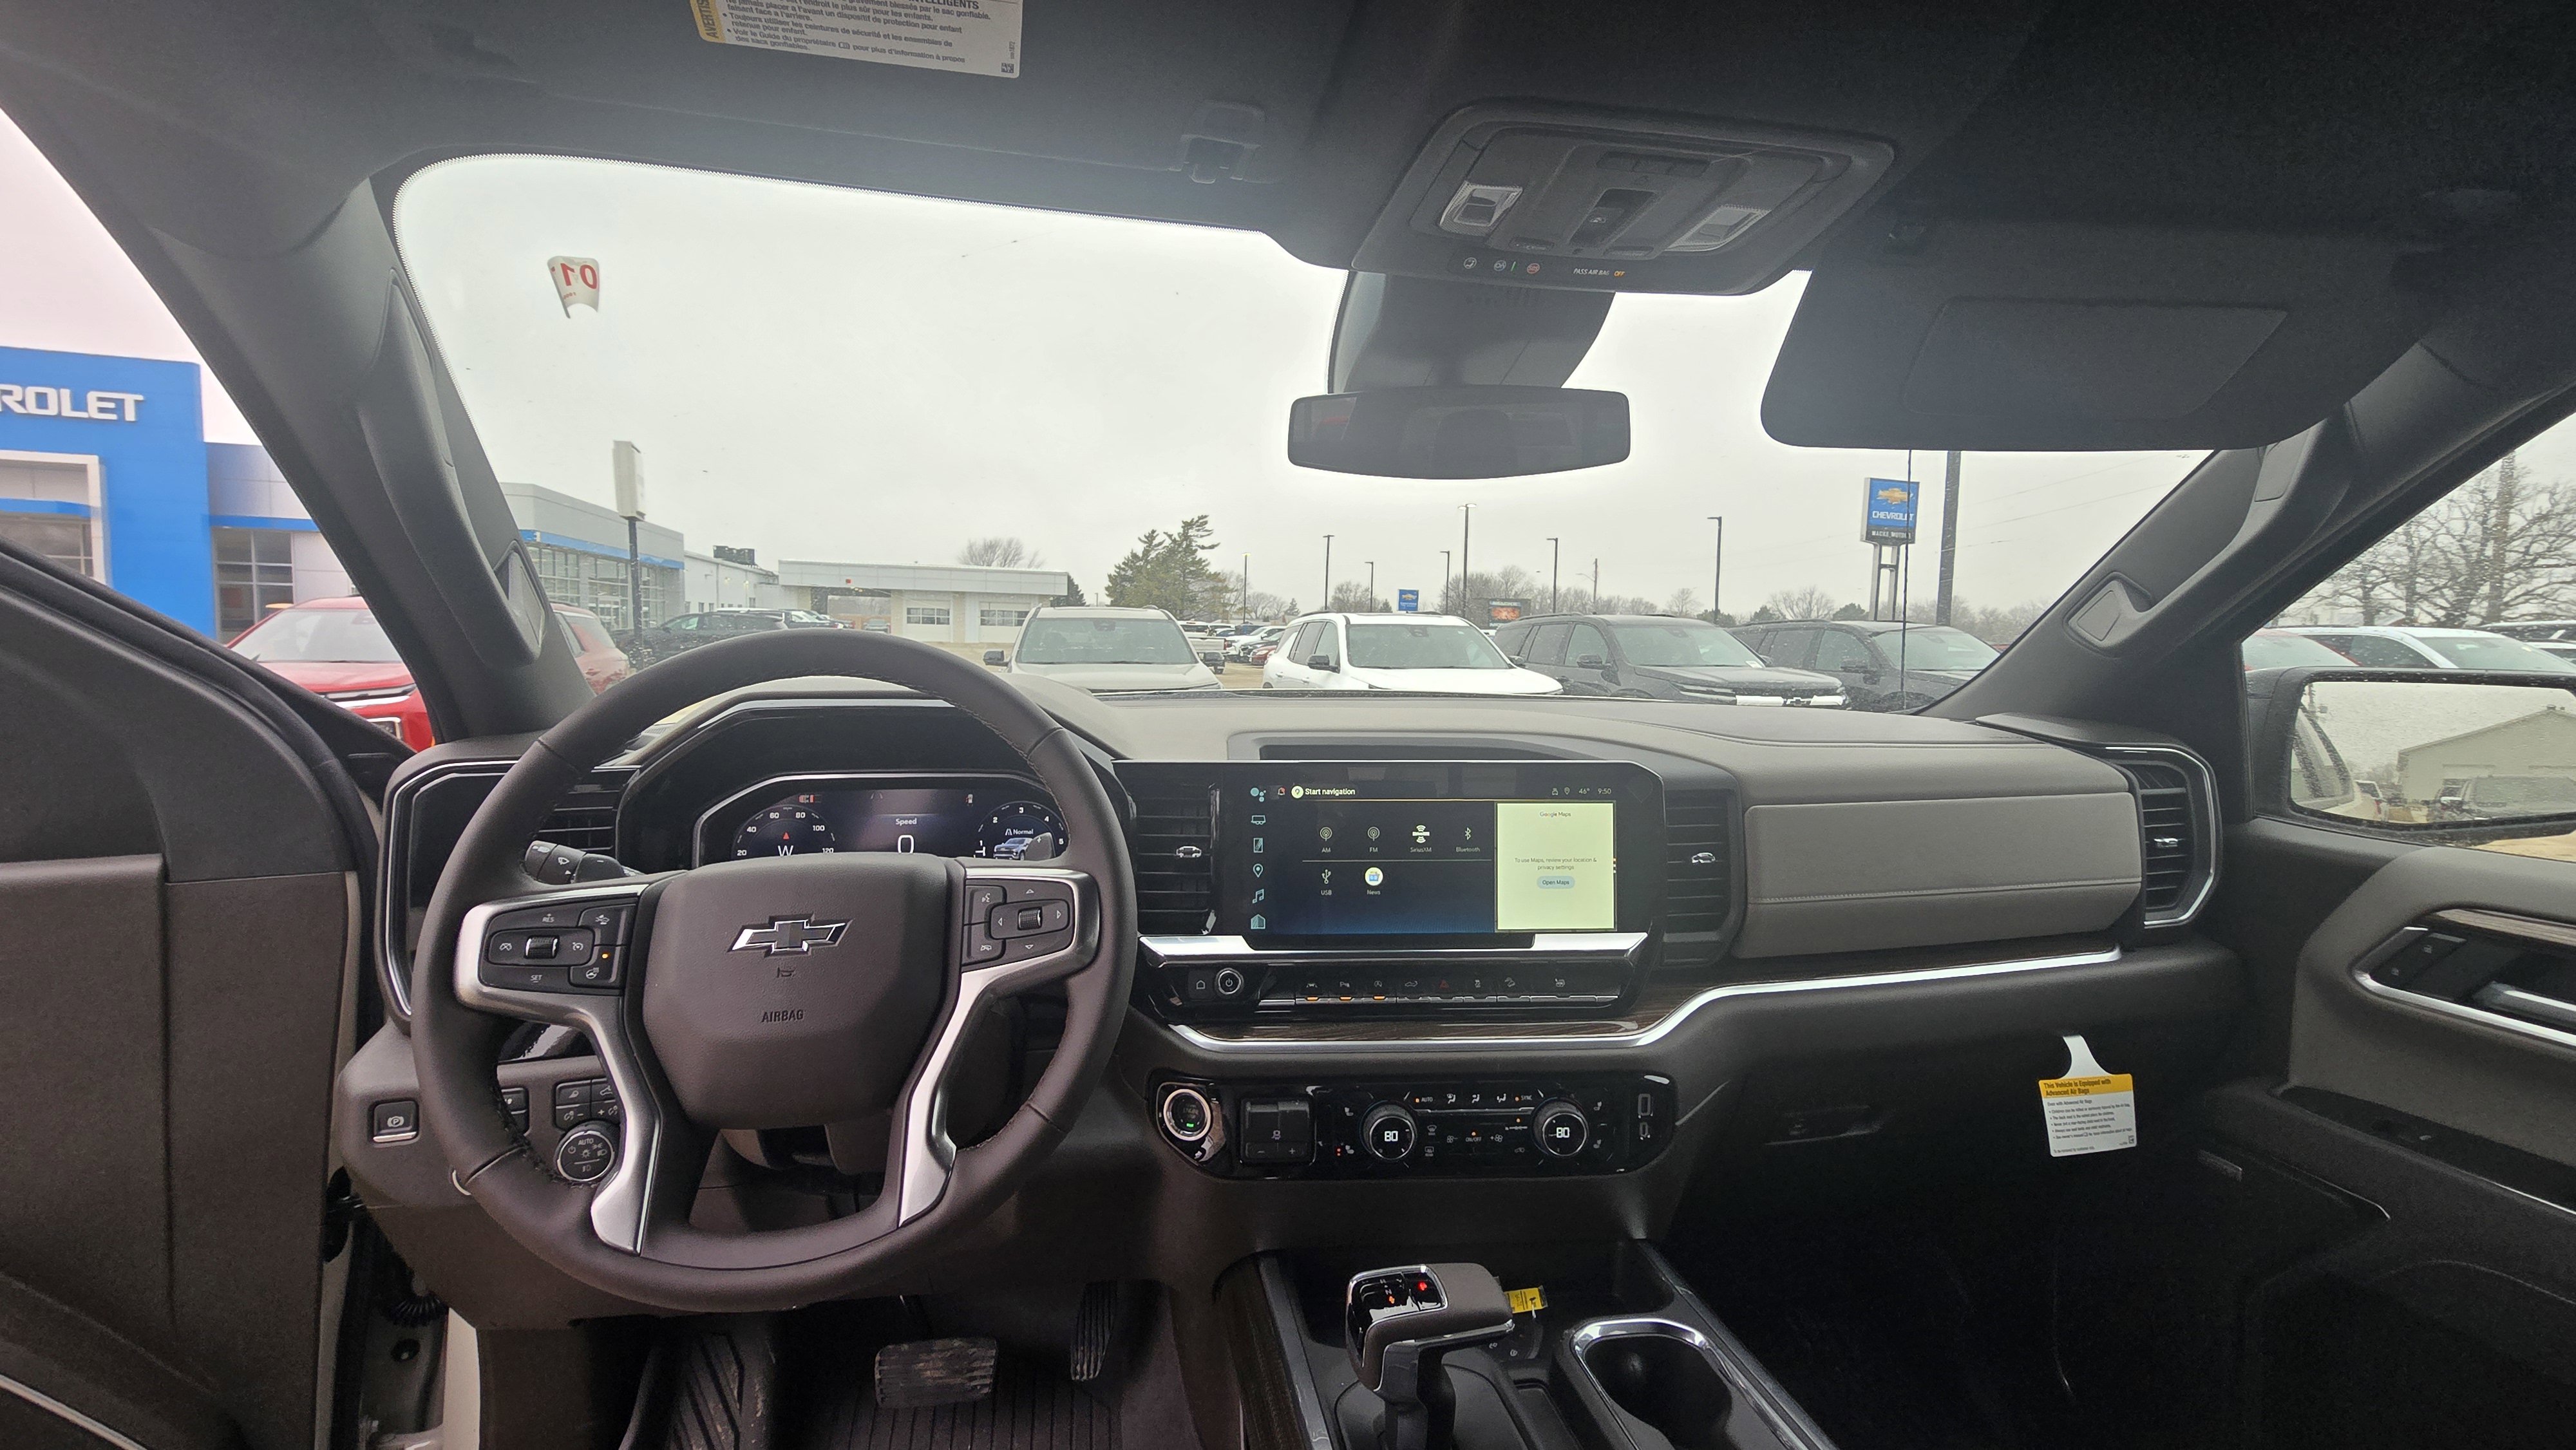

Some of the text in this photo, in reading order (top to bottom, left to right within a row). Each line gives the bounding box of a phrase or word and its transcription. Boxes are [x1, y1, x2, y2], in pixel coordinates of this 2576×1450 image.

[755, 8, 773, 16] face
[840, 3, 857, 12] plus
[872, 8, 889, 17] pour
[729, 12, 763, 23] Toujours
[883, 17, 920, 28] protection
[921, 22, 938, 30] pour
[732, 27, 748, 36] Voir
[759, 31, 781, 40] Guide
[793, 37, 837, 48] propriétaire
[887, 48, 934, 61] d'information
[942, 55, 965, 64] propos
[1305, 786, 1356, 797] Start navigation
[1558, 811, 1571, 819] Maps
[895, 818, 918, 827] Speed
[777, 845, 794, 856] W
[761, 1009, 804, 1022] AIRBAG
[1385, 1131, 1399, 1142] 80
[1556, 1127, 1571, 1138] 80
